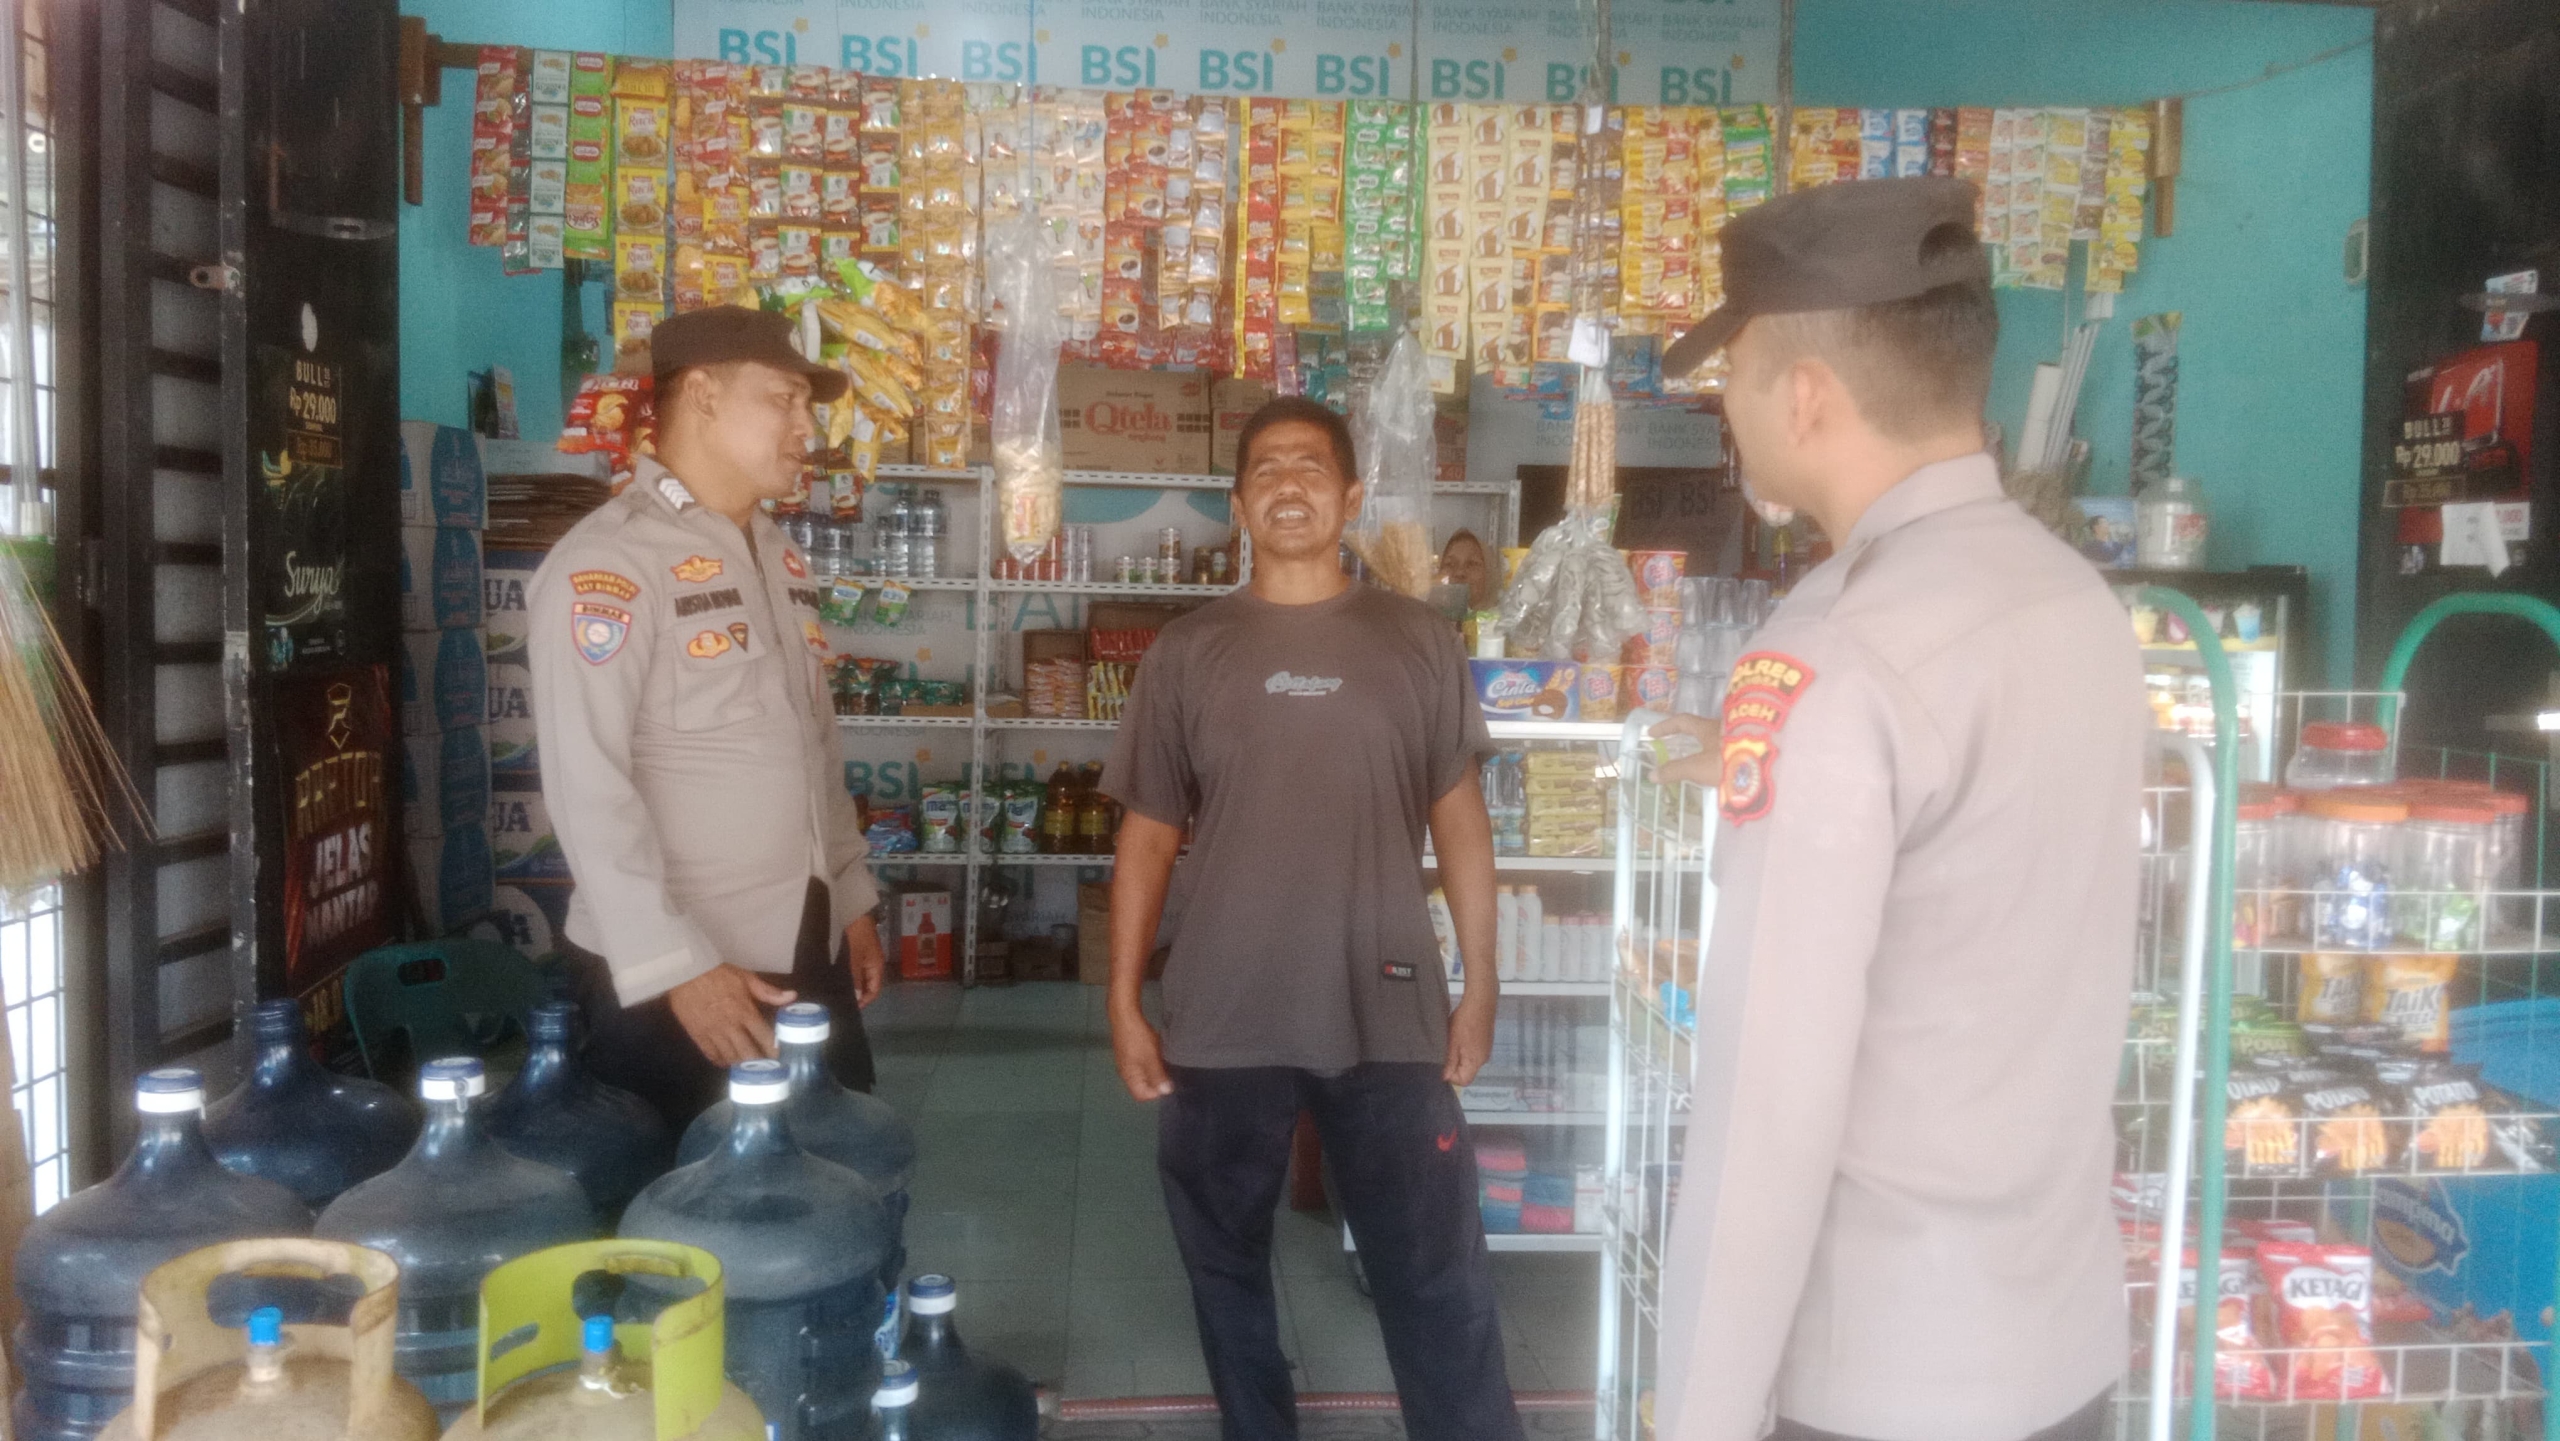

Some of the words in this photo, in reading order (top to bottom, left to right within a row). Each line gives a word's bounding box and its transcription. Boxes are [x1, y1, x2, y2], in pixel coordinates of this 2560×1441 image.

[962, 2, 1047, 17] INDONESA
[1081, 7, 1165, 22] INDONESIA
[1199, 11, 1283, 27] INDONESIA
[1316, 16, 1398, 31] INDONESIA
[1359, 4, 1422, 18] SYARIA
[1432, 21, 1513, 35] INDONESIA
[718, 28, 797, 66] BSI
[841, 34, 918, 77] BSI
[962, 40, 1037, 82] BSI
[1081, 45, 1157, 87] BSI
[1199, 50, 1274, 92] BSI
[1316, 54, 1390, 97] BSI
[1432, 58, 1504, 99] BSI
[1659, 66, 1732, 106] BSI
[296, 359, 323, 387] BULL
[1084, 401, 1173, 437] Qtela
[2404, 418, 2441, 440] BULL
[1730, 658, 1802, 687] OLRES
[1486, 679, 1537, 699] Cinta
[1728, 703, 1777, 723] ACEH
[845, 760, 919, 799] BSI
[309, 822, 373, 899] JELAS
[2226, 1076, 2281, 1101] OTATO
